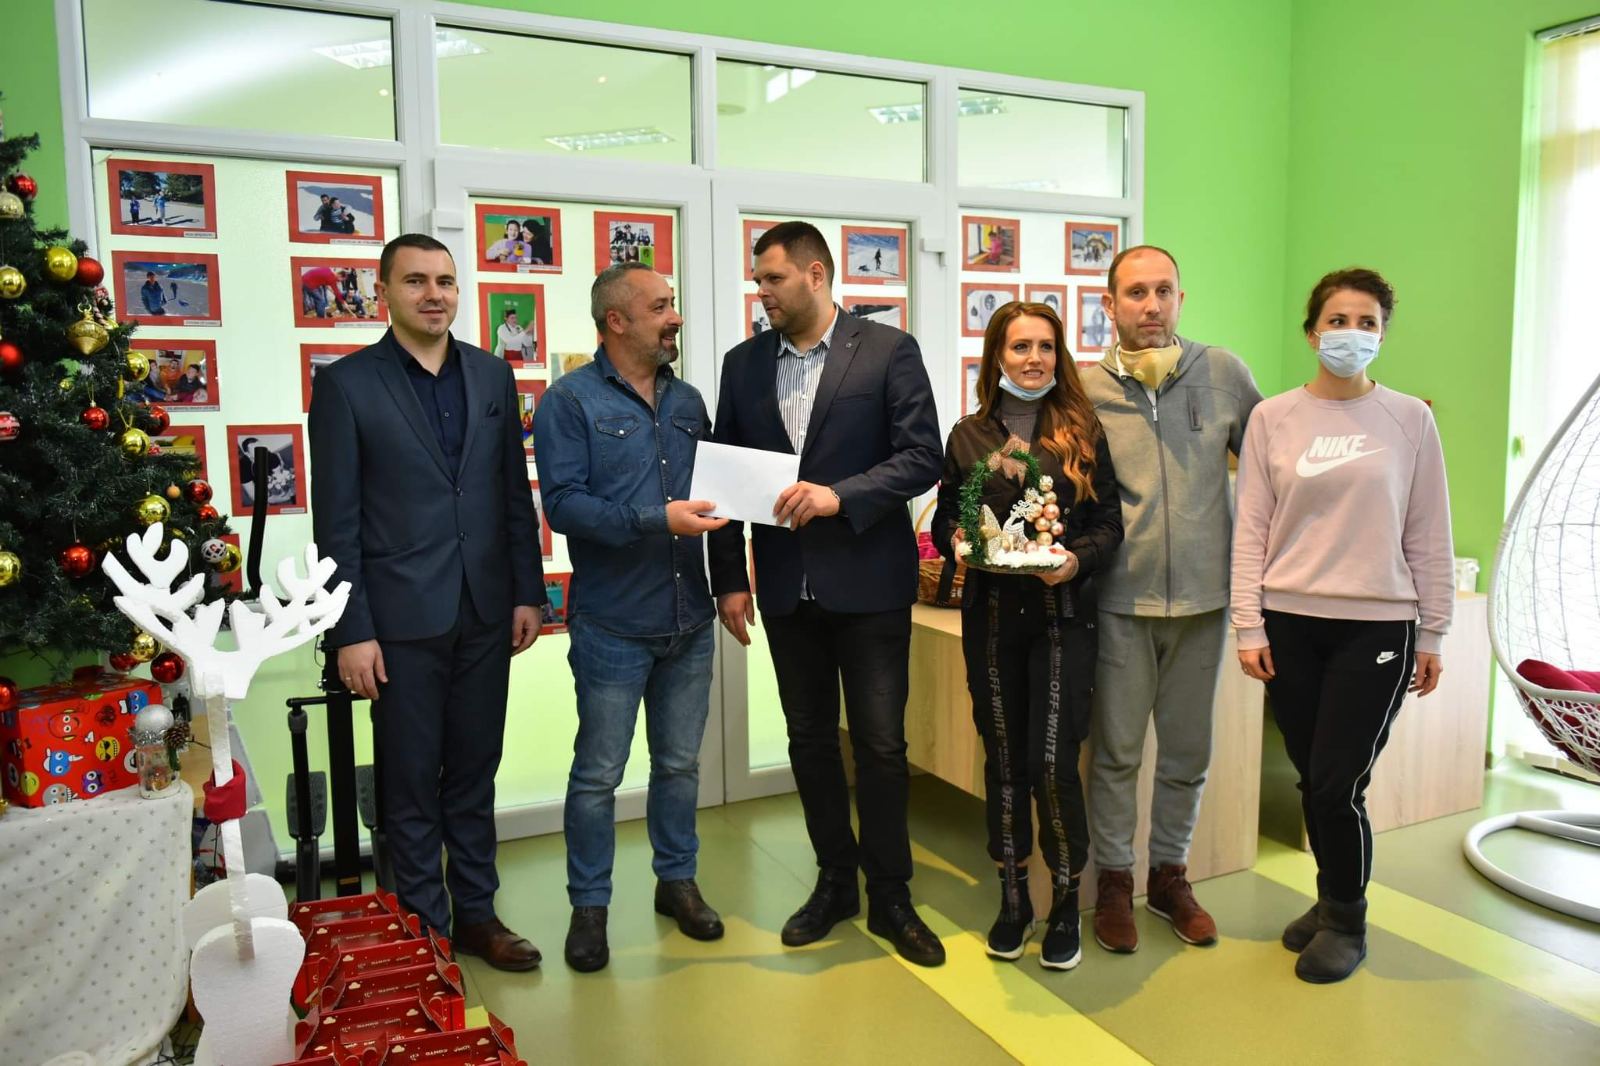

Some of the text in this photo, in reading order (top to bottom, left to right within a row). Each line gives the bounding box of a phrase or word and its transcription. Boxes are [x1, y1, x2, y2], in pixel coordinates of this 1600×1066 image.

[1308, 434, 1367, 458] NIKE
[987, 667, 1007, 737] OFF-WHITE
[1044, 680, 1062, 763] OFF-WHITE
[1001, 784, 1015, 856] OFF-WHITE
[1051, 819, 1071, 885] OFF-WHITE
